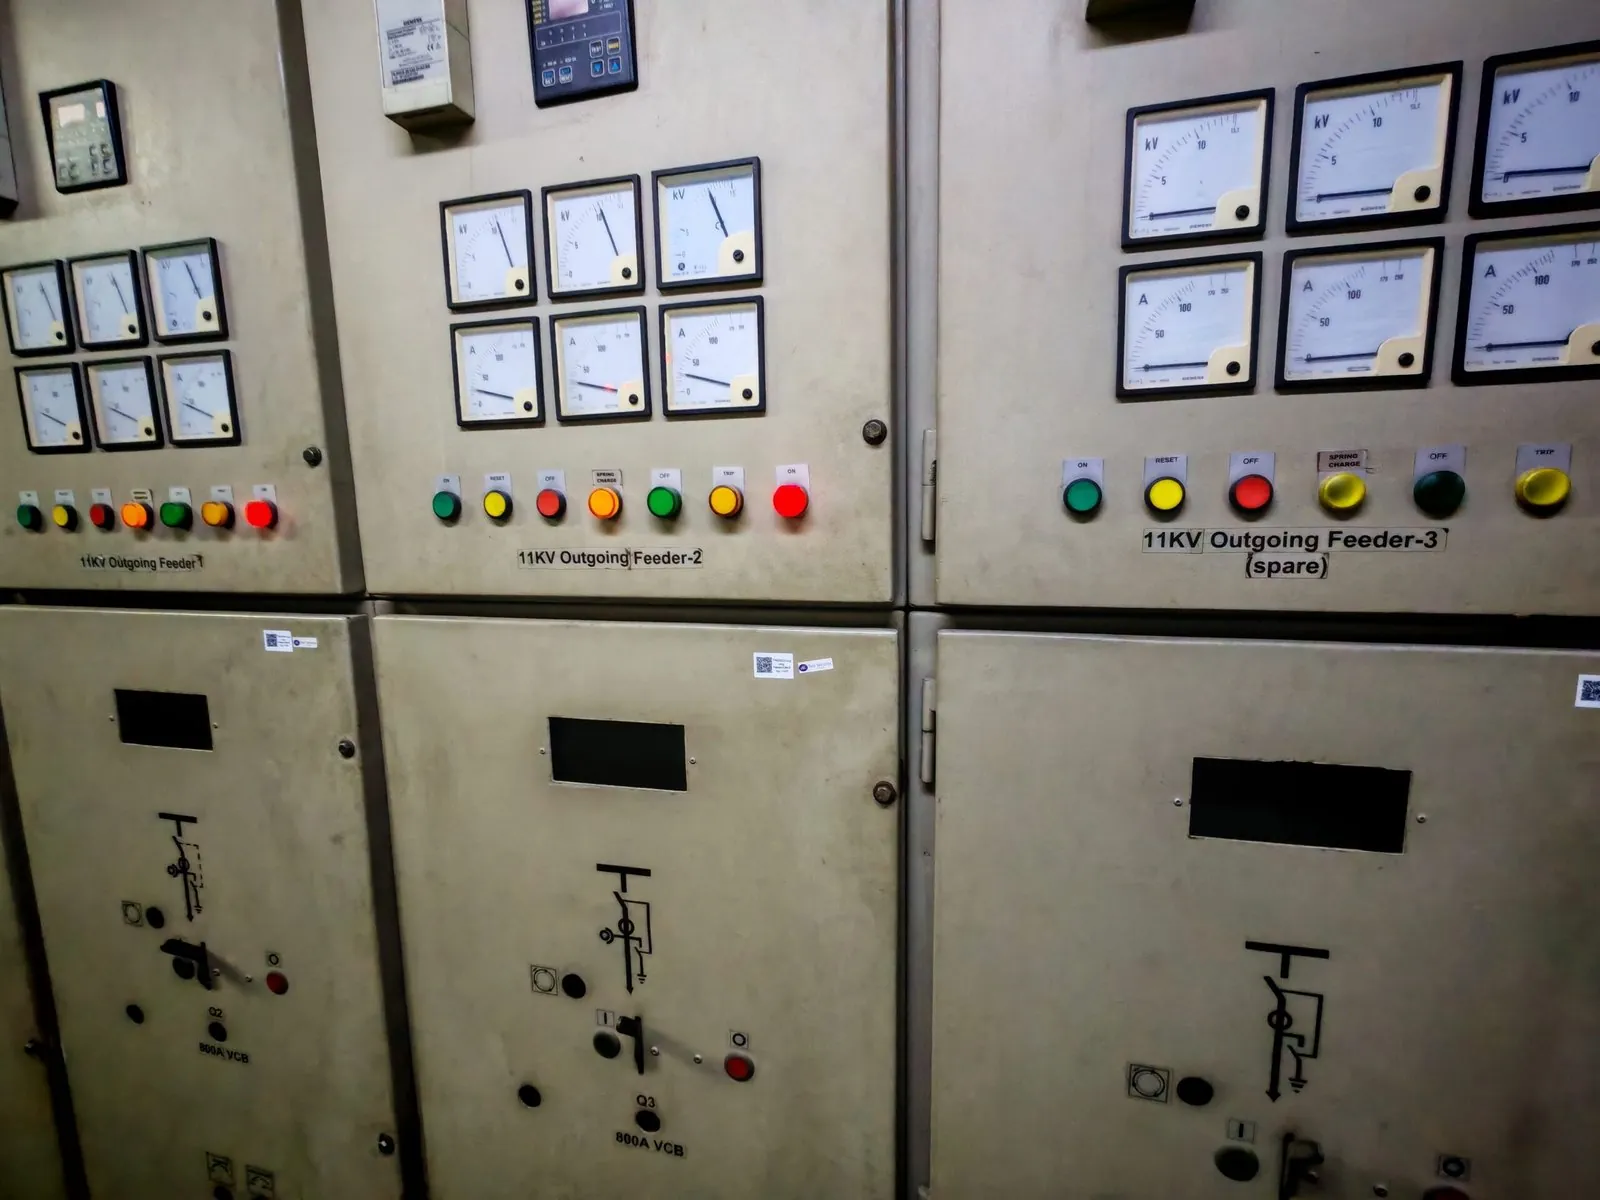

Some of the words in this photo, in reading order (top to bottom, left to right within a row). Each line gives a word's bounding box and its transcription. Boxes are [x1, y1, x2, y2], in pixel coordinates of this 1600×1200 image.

[1503, 89, 1521, 105] kV
[1569, 91, 1580, 103] 10
[1314, 114, 1329, 128] kV
[1372, 117, 1382, 128] 10
[1521, 133, 1527, 143] 5
[1145, 137, 1159, 151] kV
[1198, 140, 1207, 150] 10
[1331, 157, 1336, 166] 5
[1161, 176, 1166, 186] 5
[673, 188, 685, 200] kV
[561, 210, 569, 221] kV
[1484, 264, 1496, 278] A
[1303, 280, 1313, 291] A
[1535, 275, 1550, 285] 100
[1138, 294, 1148, 305] A
[1347, 289, 1361, 300] 100
[1179, 303, 1192, 313] 100
[1503, 305, 1514, 315] 50
[1320, 318, 1330, 327] 50
[679, 328, 686, 338] A
[1155, 330, 1164, 339] 50
[569, 337, 576, 345] A
[709, 337, 718, 345] 100
[470, 346, 476, 354] A
[692, 358, 700, 366] 50
[1143, 531, 1202, 549] 11KV
[1210, 531, 1319, 553] Outgoing
[1327, 530, 1438, 549] Feeder-3
[80, 556, 105, 568] 11KV
[108, 557, 157, 571] Outgoing
[519, 551, 555, 565] 11KV
[560, 550, 629, 567] Outgoing
[634, 550, 702, 565] Feeder-2
[1245, 554, 1328, 578] (spare)
[199, 1042, 224, 1057] 800A
[226, 1050, 249, 1063] VCB
[636, 1094, 656, 1108] Q3
[616, 1132, 650, 1149] 800A
[653, 1140, 684, 1157] VCB
